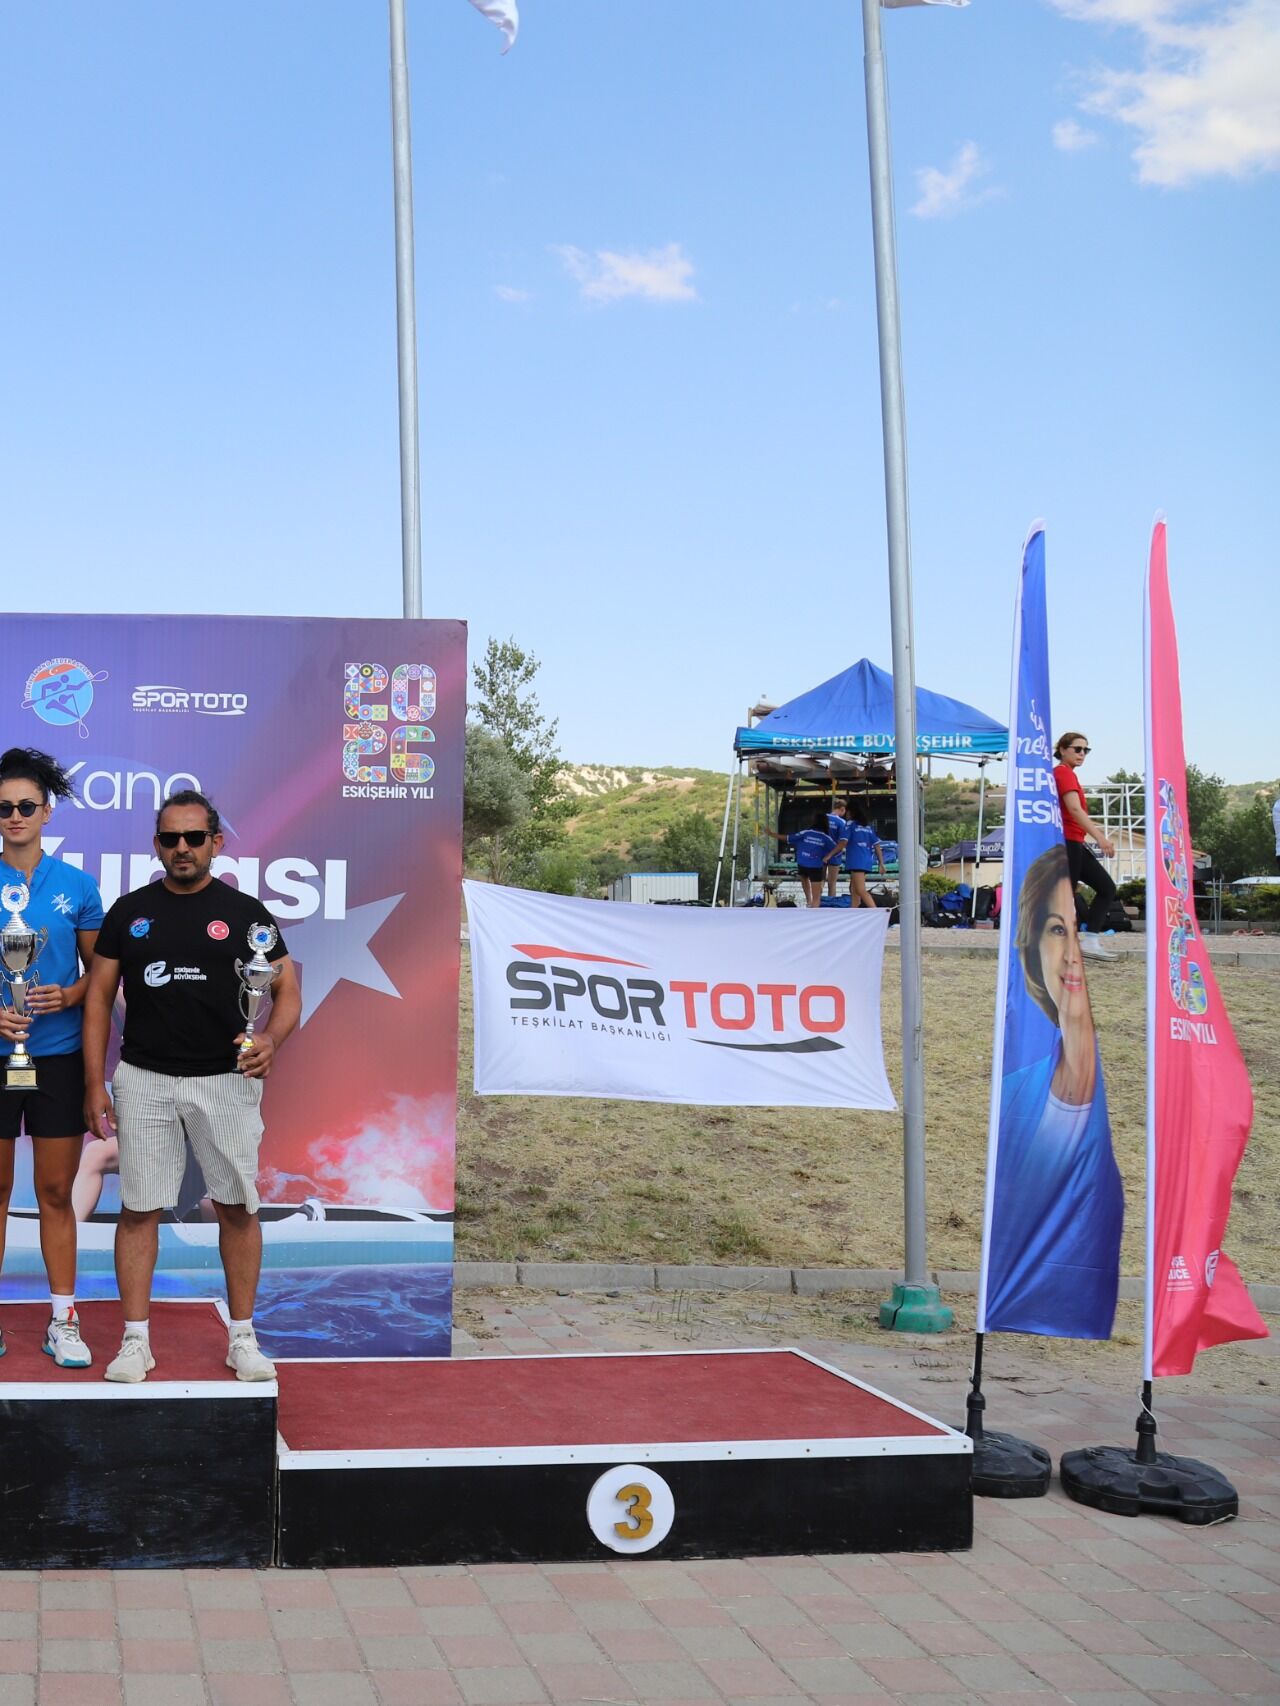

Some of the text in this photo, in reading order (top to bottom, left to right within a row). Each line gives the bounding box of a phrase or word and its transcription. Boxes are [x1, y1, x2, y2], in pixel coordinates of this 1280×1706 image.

[342, 783, 434, 800] ESKİŞEHİR YILI
[511, 1016, 672, 1042] TEŞKİLAT BAŞKANLIĞI
[614, 1482, 654, 1540] 3
